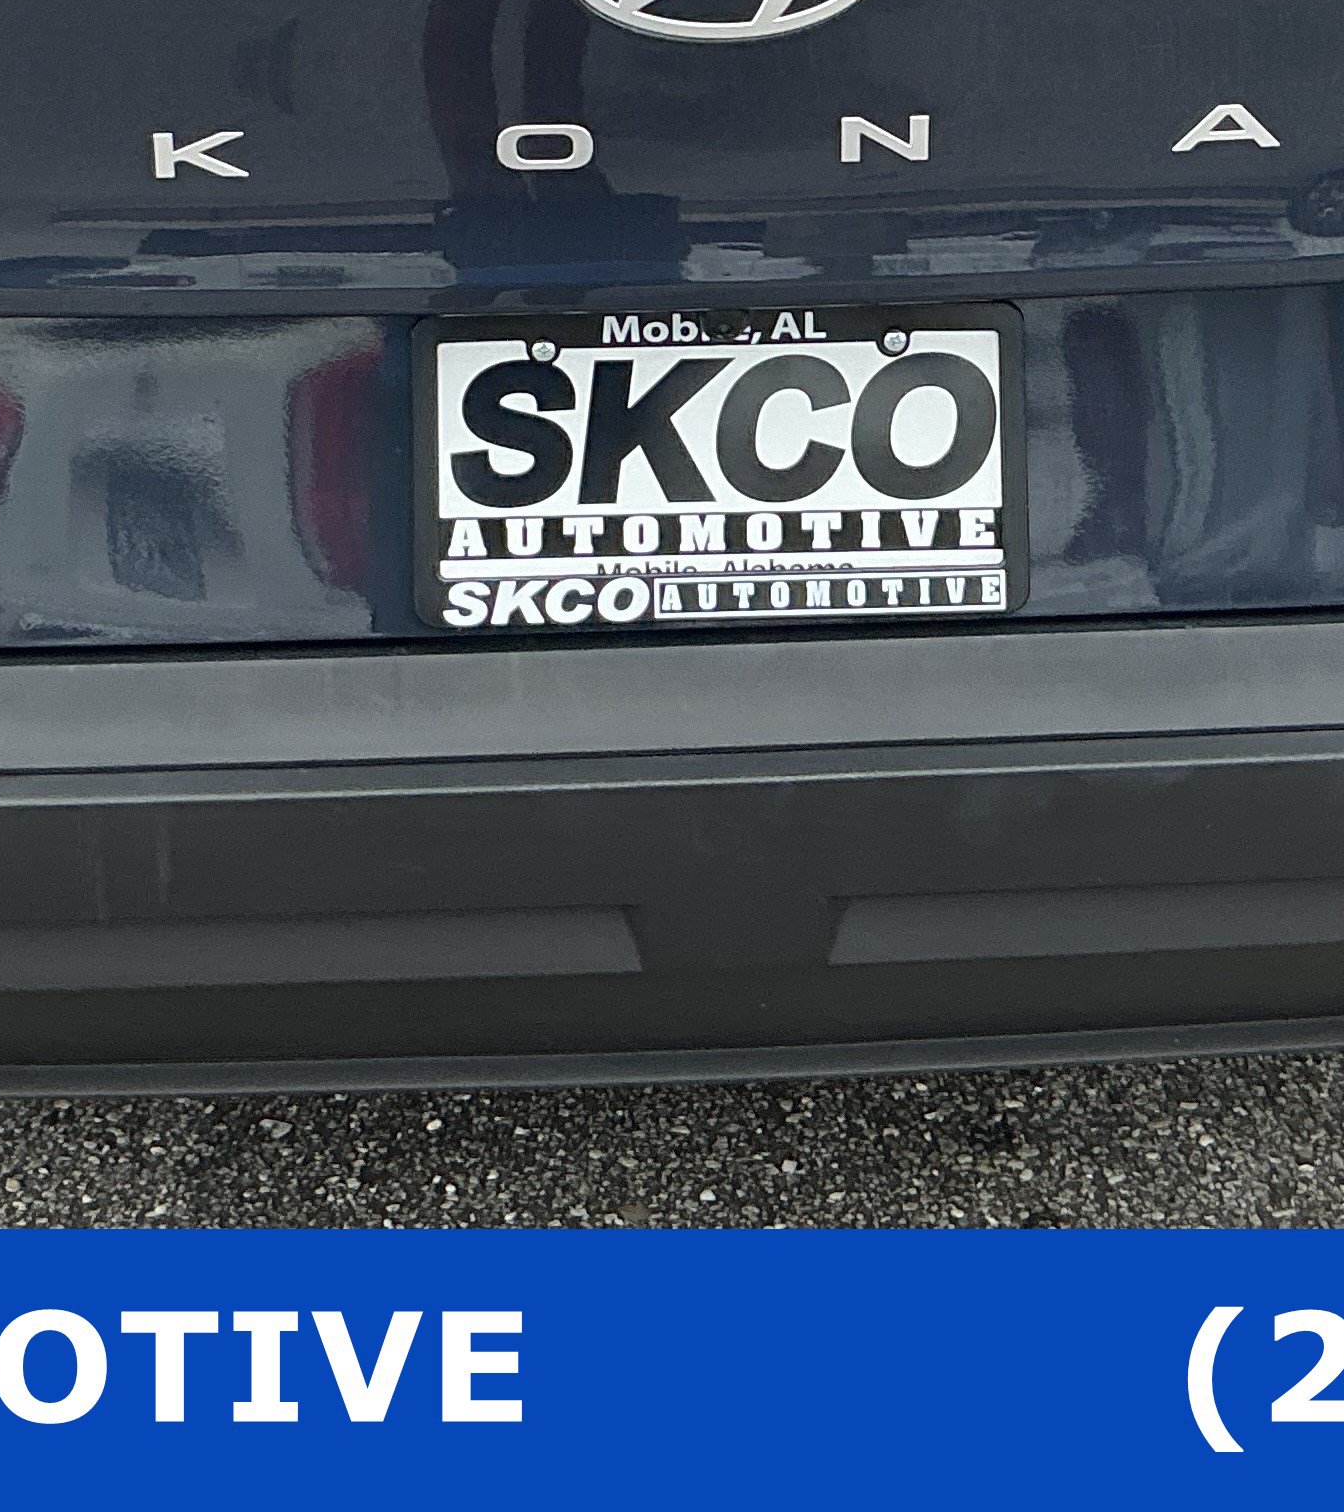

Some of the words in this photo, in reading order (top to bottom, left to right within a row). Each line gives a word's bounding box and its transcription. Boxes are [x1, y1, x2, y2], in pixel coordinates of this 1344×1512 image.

[153, 104, 1280, 179] KONA
[602, 312, 762, 345] Mob,
[771, 311, 827, 340] AL
[450, 352, 997, 508] SKCO
[448, 509, 996, 558] AUTOMOTIVE
[442, 576, 651, 627] SKCO
[661, 575, 1001, 611] AUTOMOTIVE
